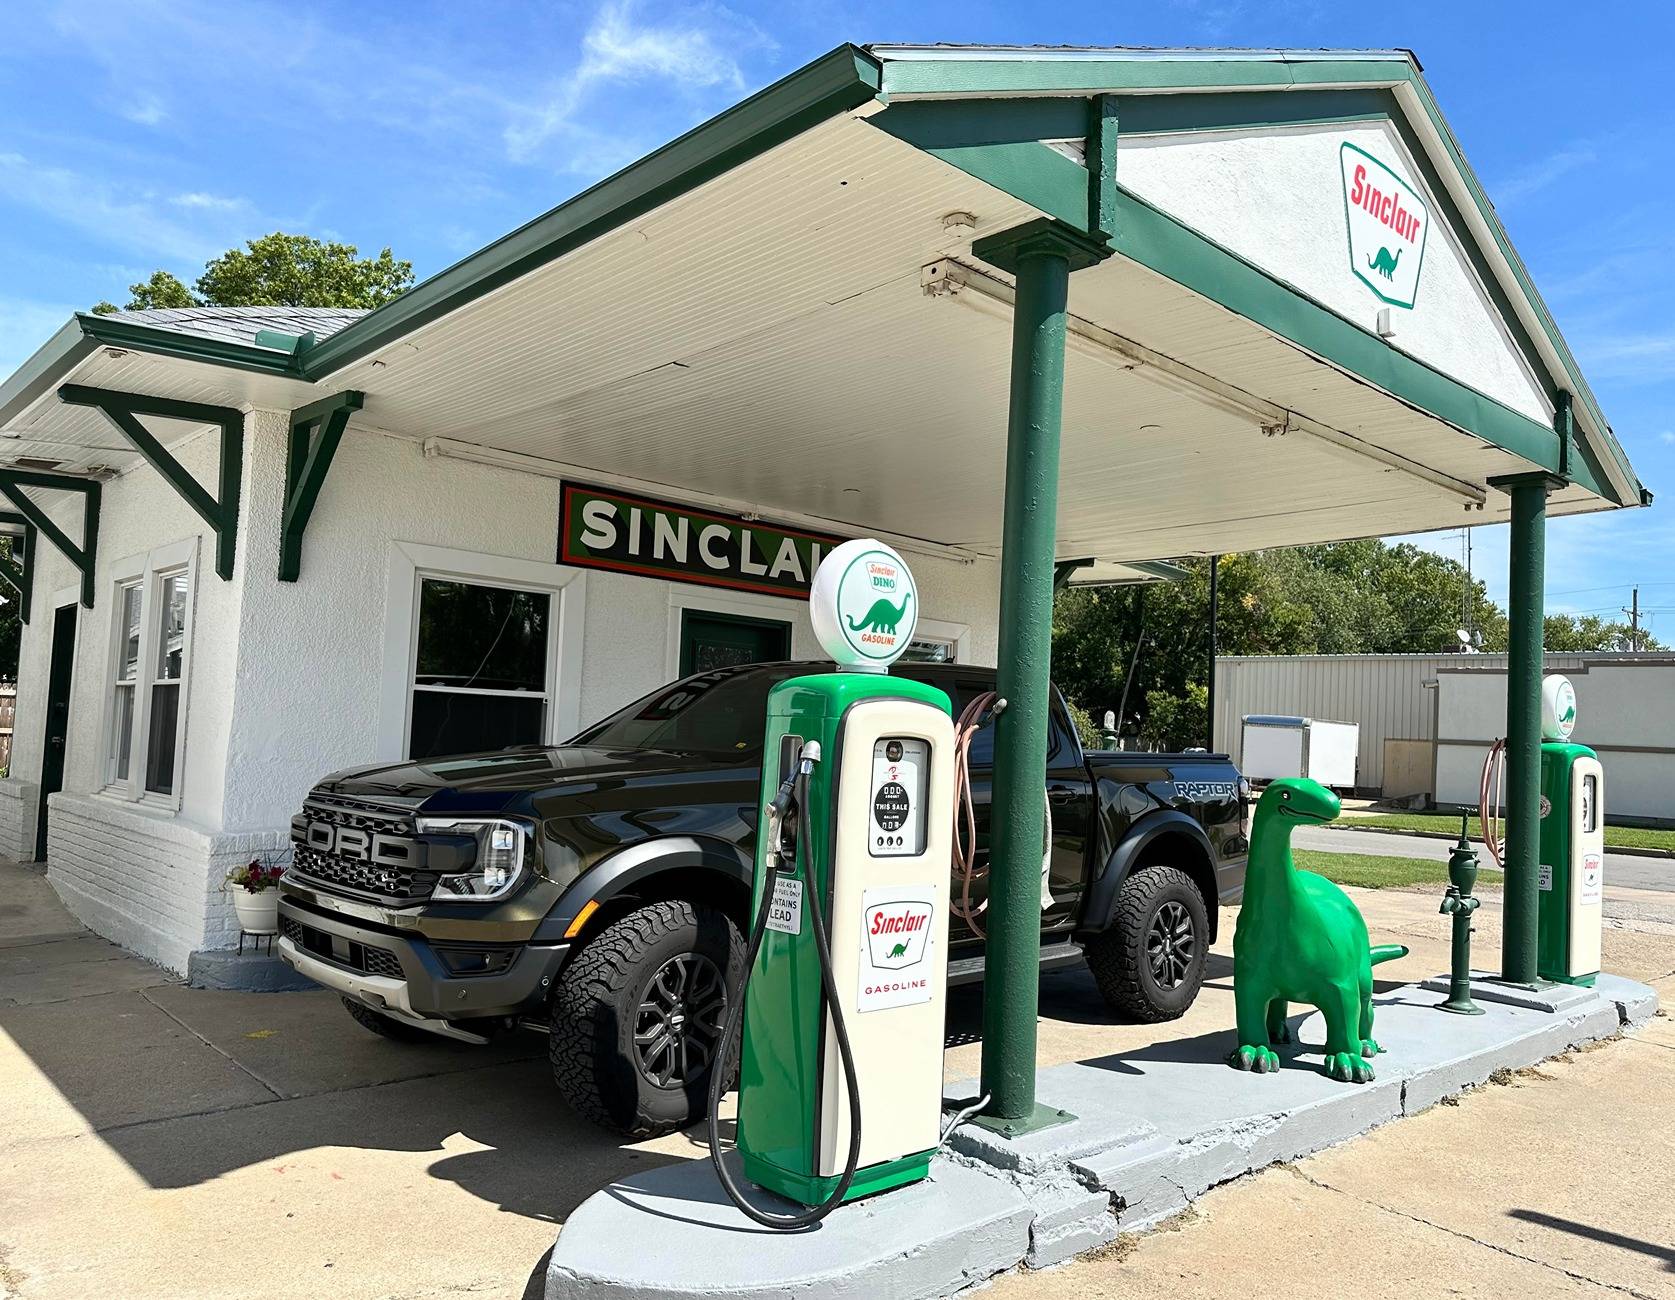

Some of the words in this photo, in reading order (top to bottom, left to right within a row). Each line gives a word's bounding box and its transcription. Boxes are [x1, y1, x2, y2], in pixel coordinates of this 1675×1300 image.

[1351, 164, 1420, 244] Sinclair
[579, 499, 825, 583] SINCLAI
[869, 563, 895, 576] Sinclair
[872, 576, 895, 588] DINO
[861, 633, 896, 646] GASOLINE
[1173, 781, 1239, 803] RAPTOR
[892, 803, 908, 811] SALE
[771, 897, 797, 909] ONTAINS
[769, 908, 791, 922] LEAD
[870, 910, 928, 935] Sinclair
[865, 979, 927, 995] GASOLINE
